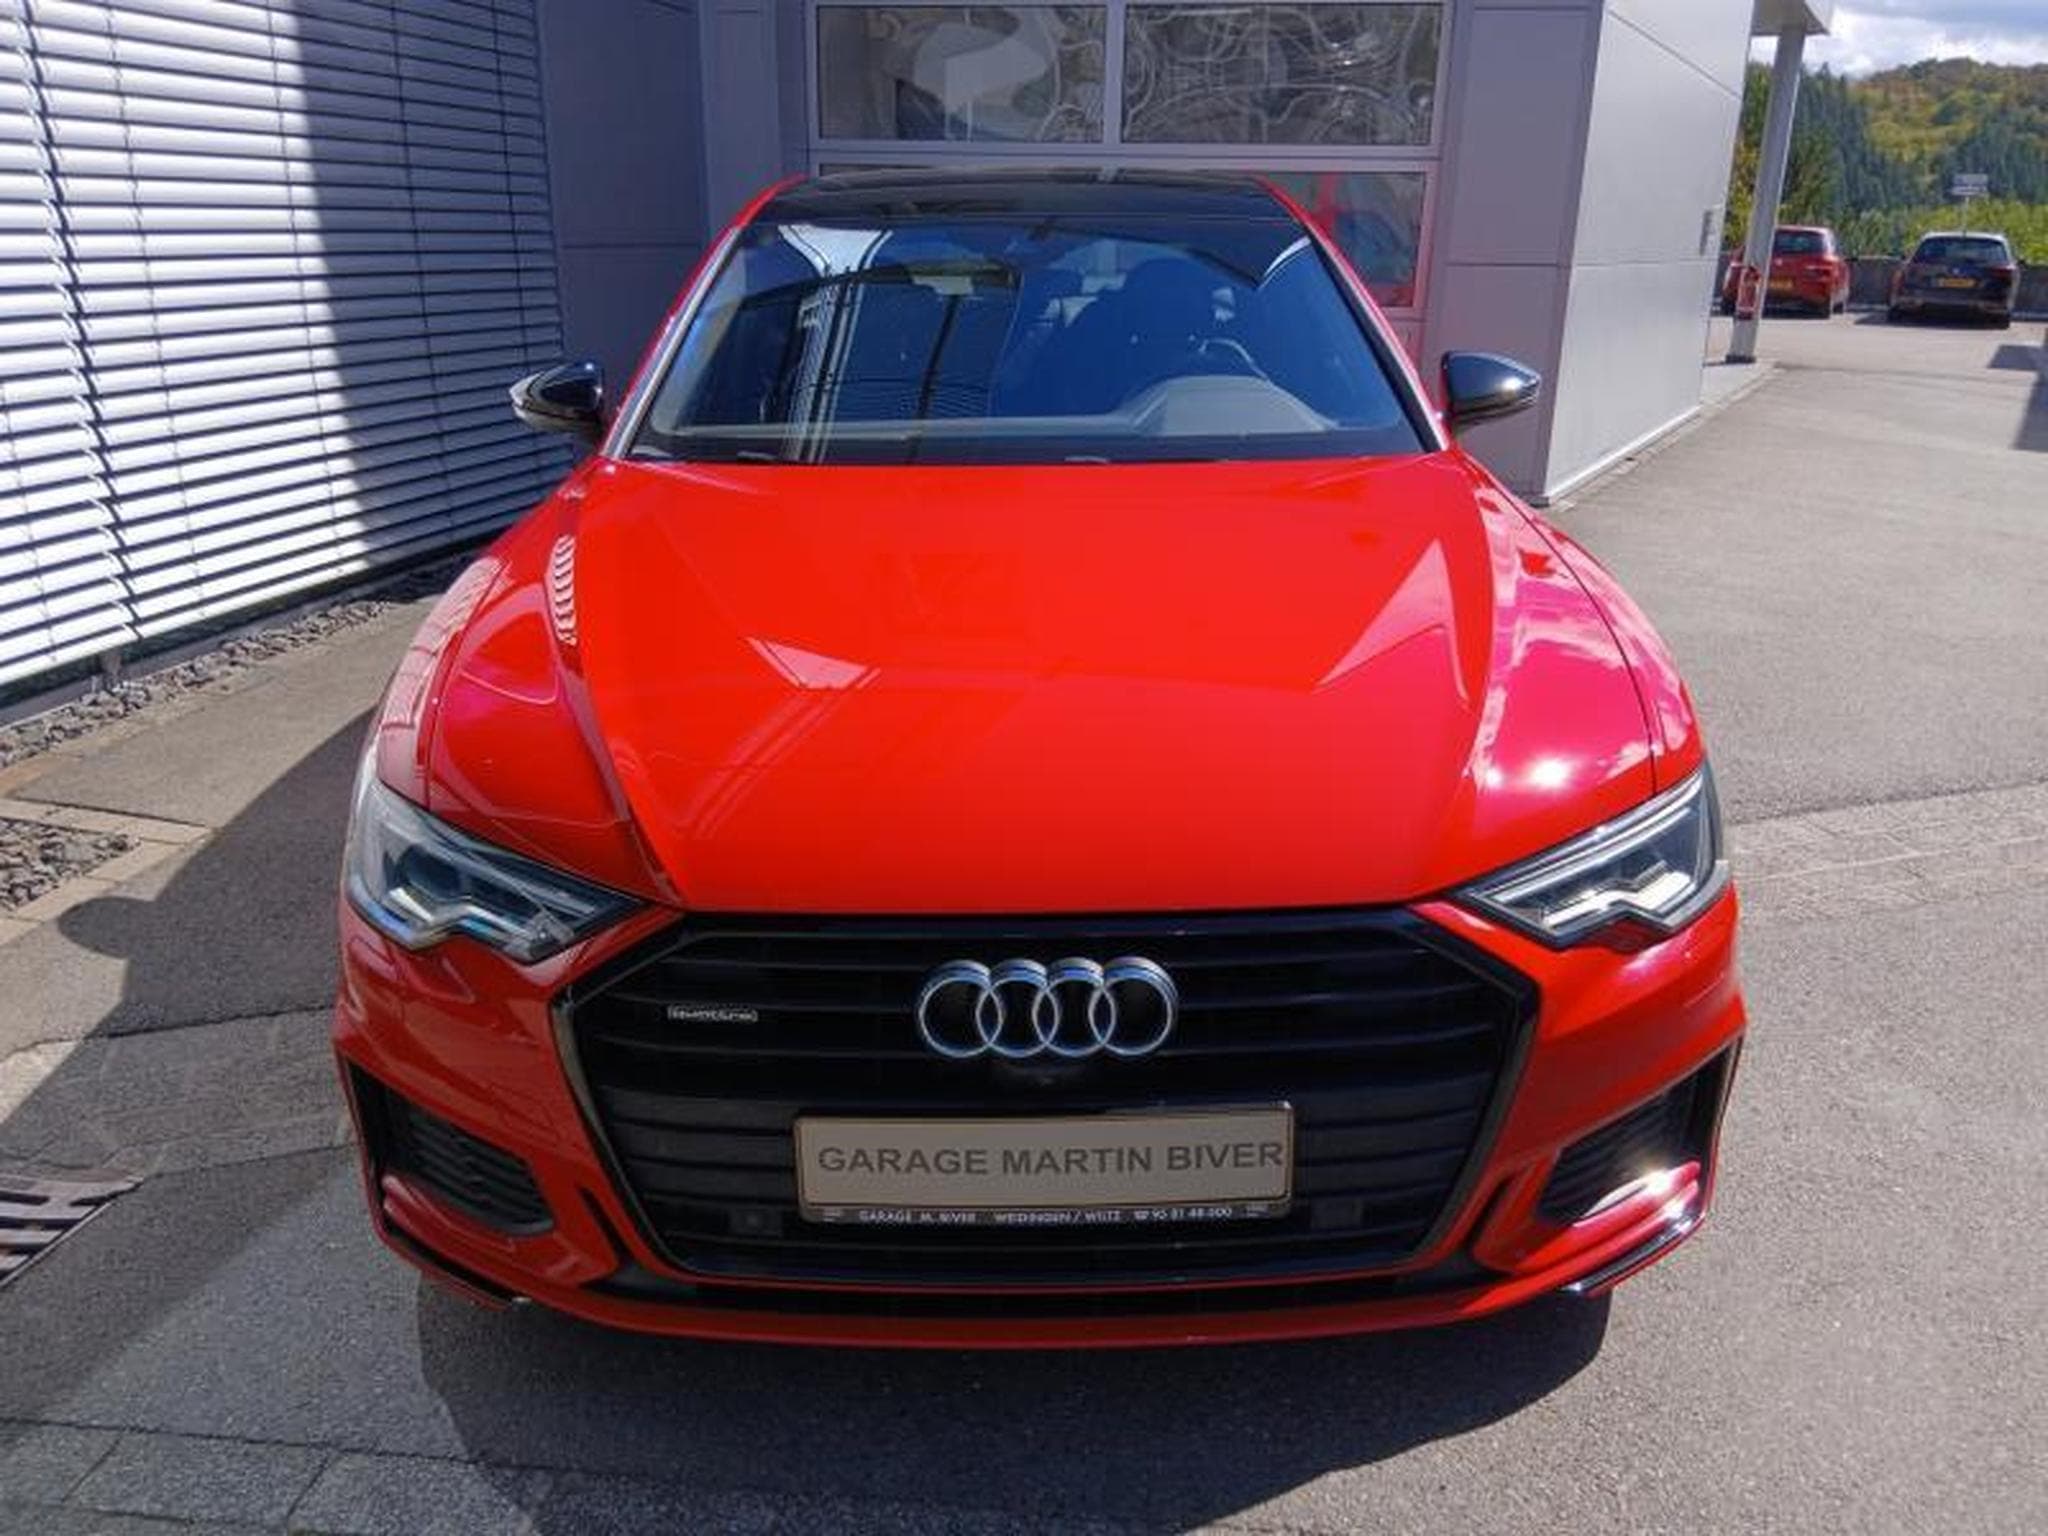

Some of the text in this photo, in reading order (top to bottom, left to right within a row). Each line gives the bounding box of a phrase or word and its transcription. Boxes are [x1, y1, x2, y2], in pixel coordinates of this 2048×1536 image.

[818, 1142, 1284, 1175] GARAGE MARTIN BIVER
[859, 1210, 911, 1223] GARAGE
